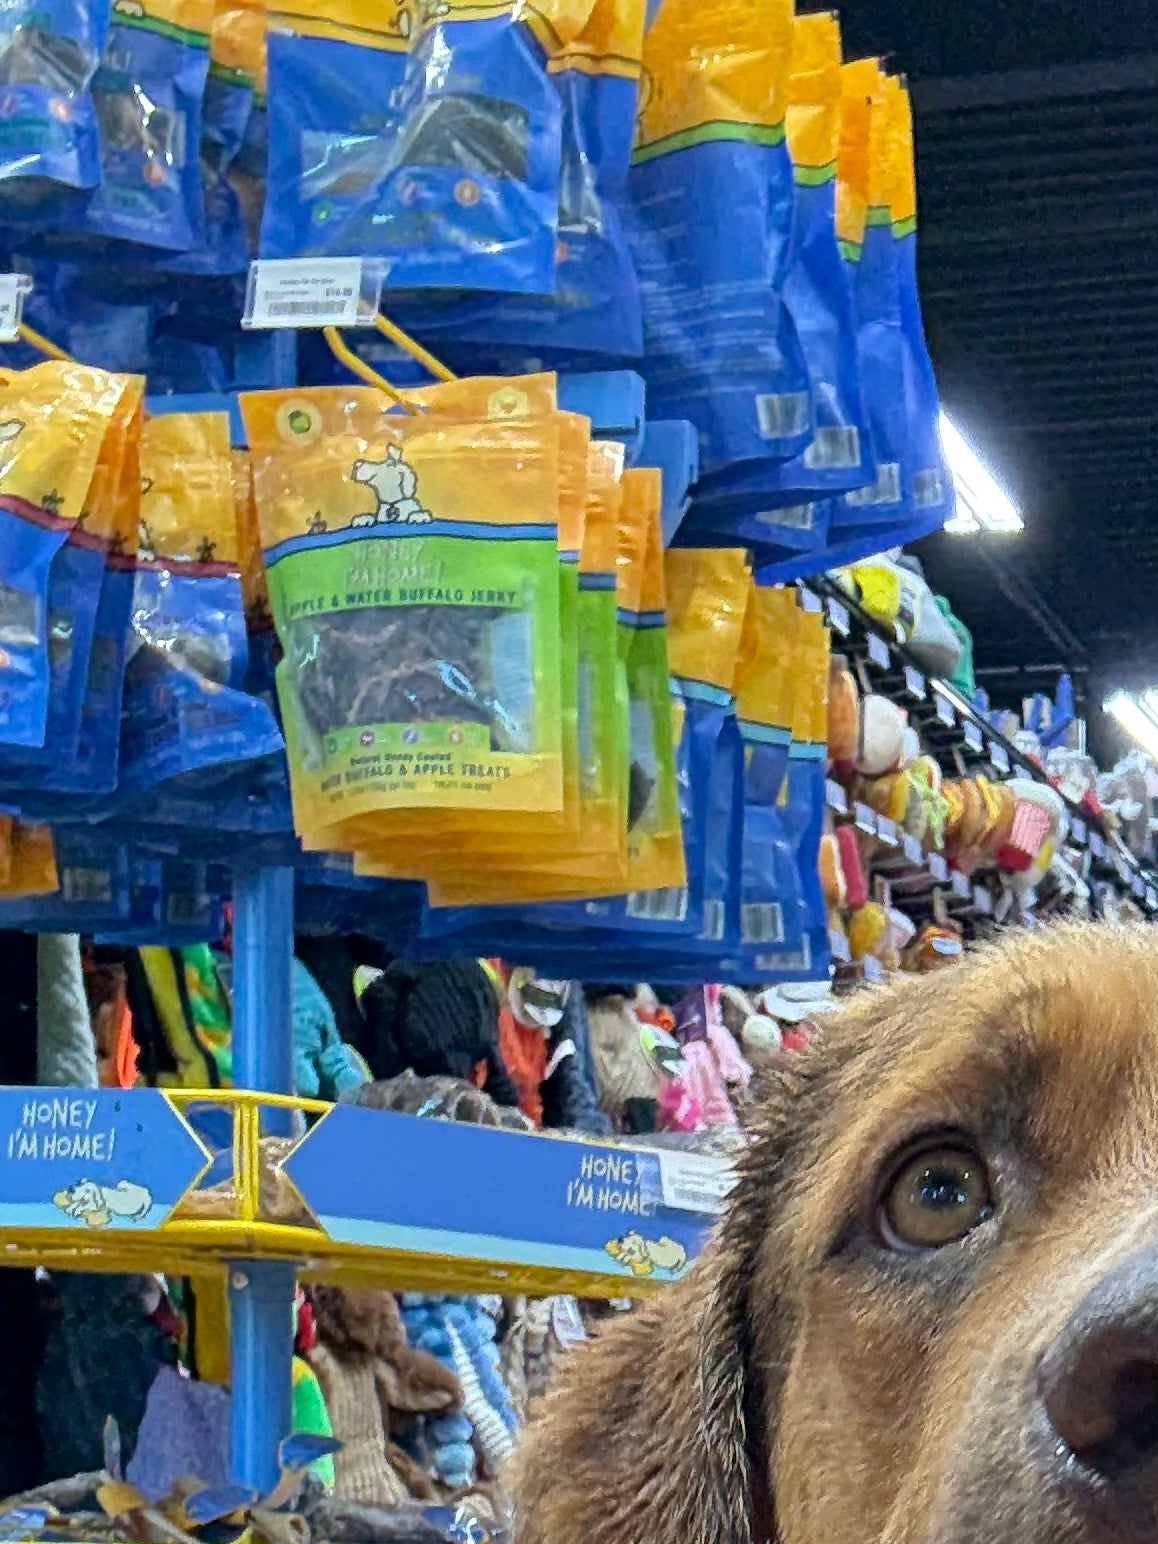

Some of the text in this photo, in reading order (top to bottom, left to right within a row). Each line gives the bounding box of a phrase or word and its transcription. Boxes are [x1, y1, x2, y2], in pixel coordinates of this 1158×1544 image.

[346, 589, 391, 604] WATER
[400, 587, 463, 602] BUFFALO
[471, 588, 516, 605] JERKY
[414, 763, 455, 776] APPLE
[462, 763, 511, 780] TREATS
[22, 1097, 97, 1130] HONEY
[7, 1127, 116, 1161] I'M HOME!
[567, 1178, 593, 1209] I'M
